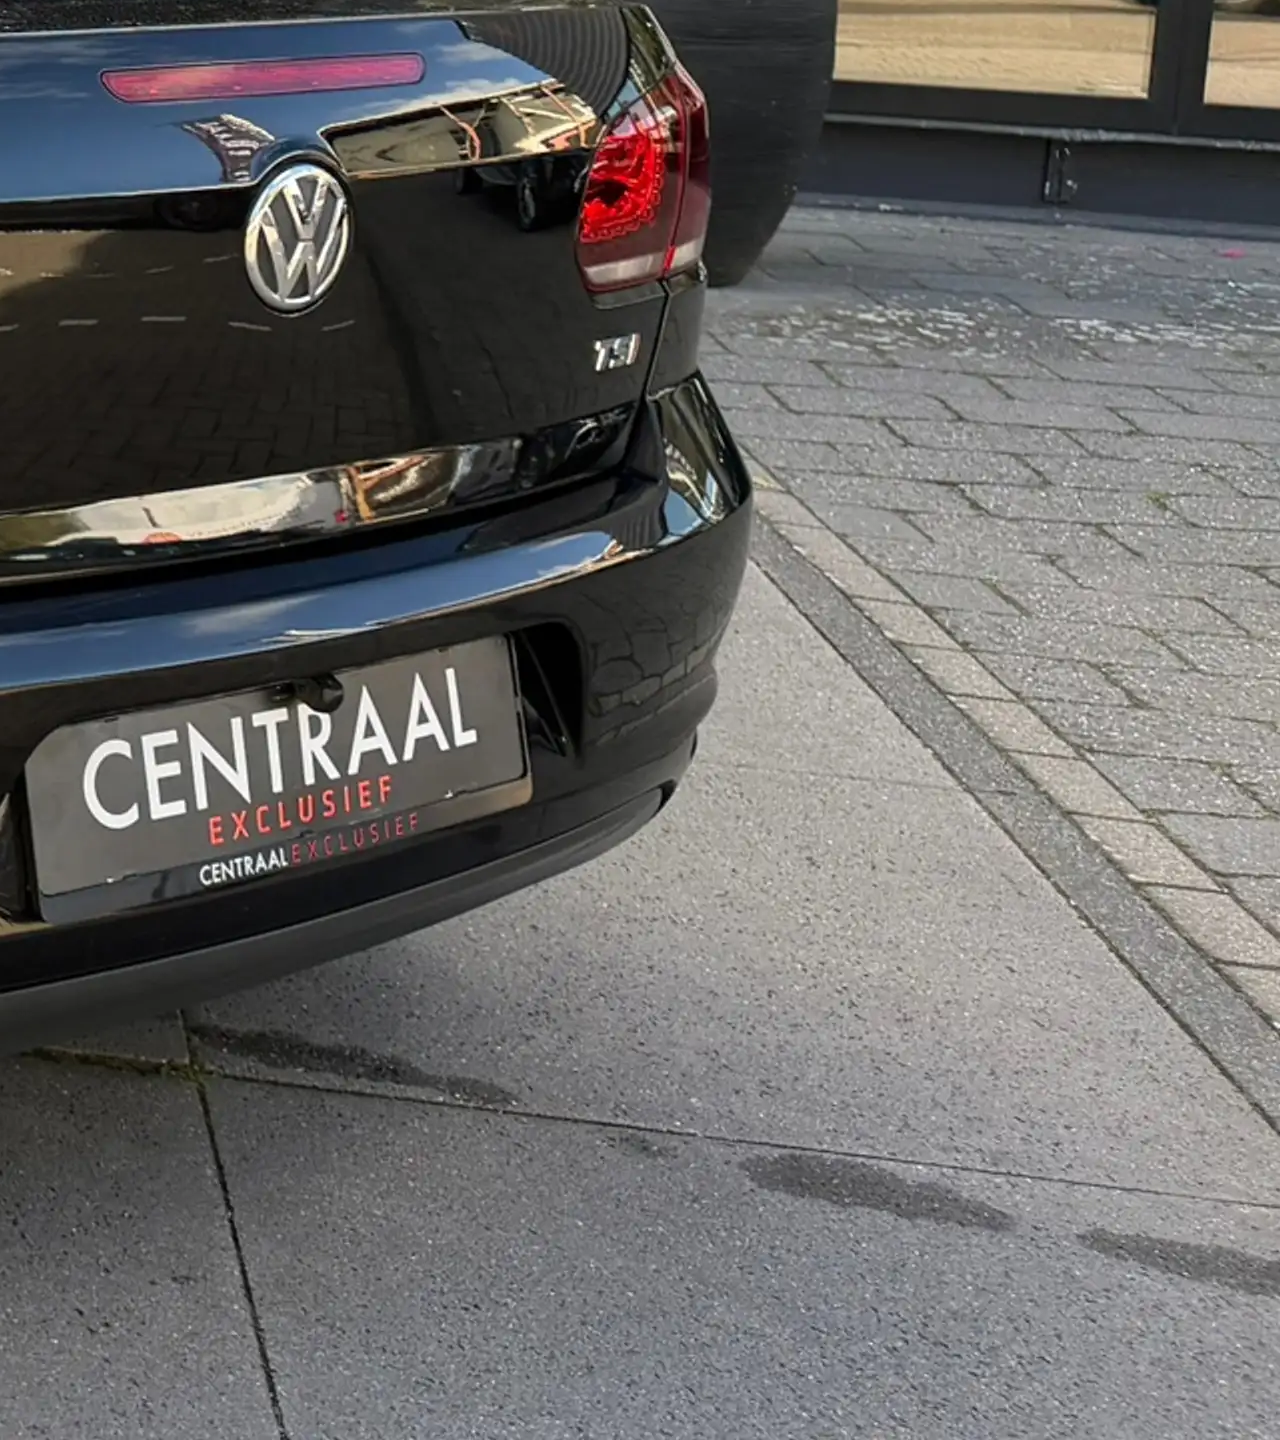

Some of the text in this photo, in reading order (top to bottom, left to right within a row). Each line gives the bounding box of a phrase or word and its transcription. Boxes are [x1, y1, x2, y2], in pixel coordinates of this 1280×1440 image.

[82, 666, 478, 830] CENTRAAL
[208, 774, 393, 846] EXCLUSIEF
[199, 811, 420, 886] CENTRAAL EXCLUSIEF
